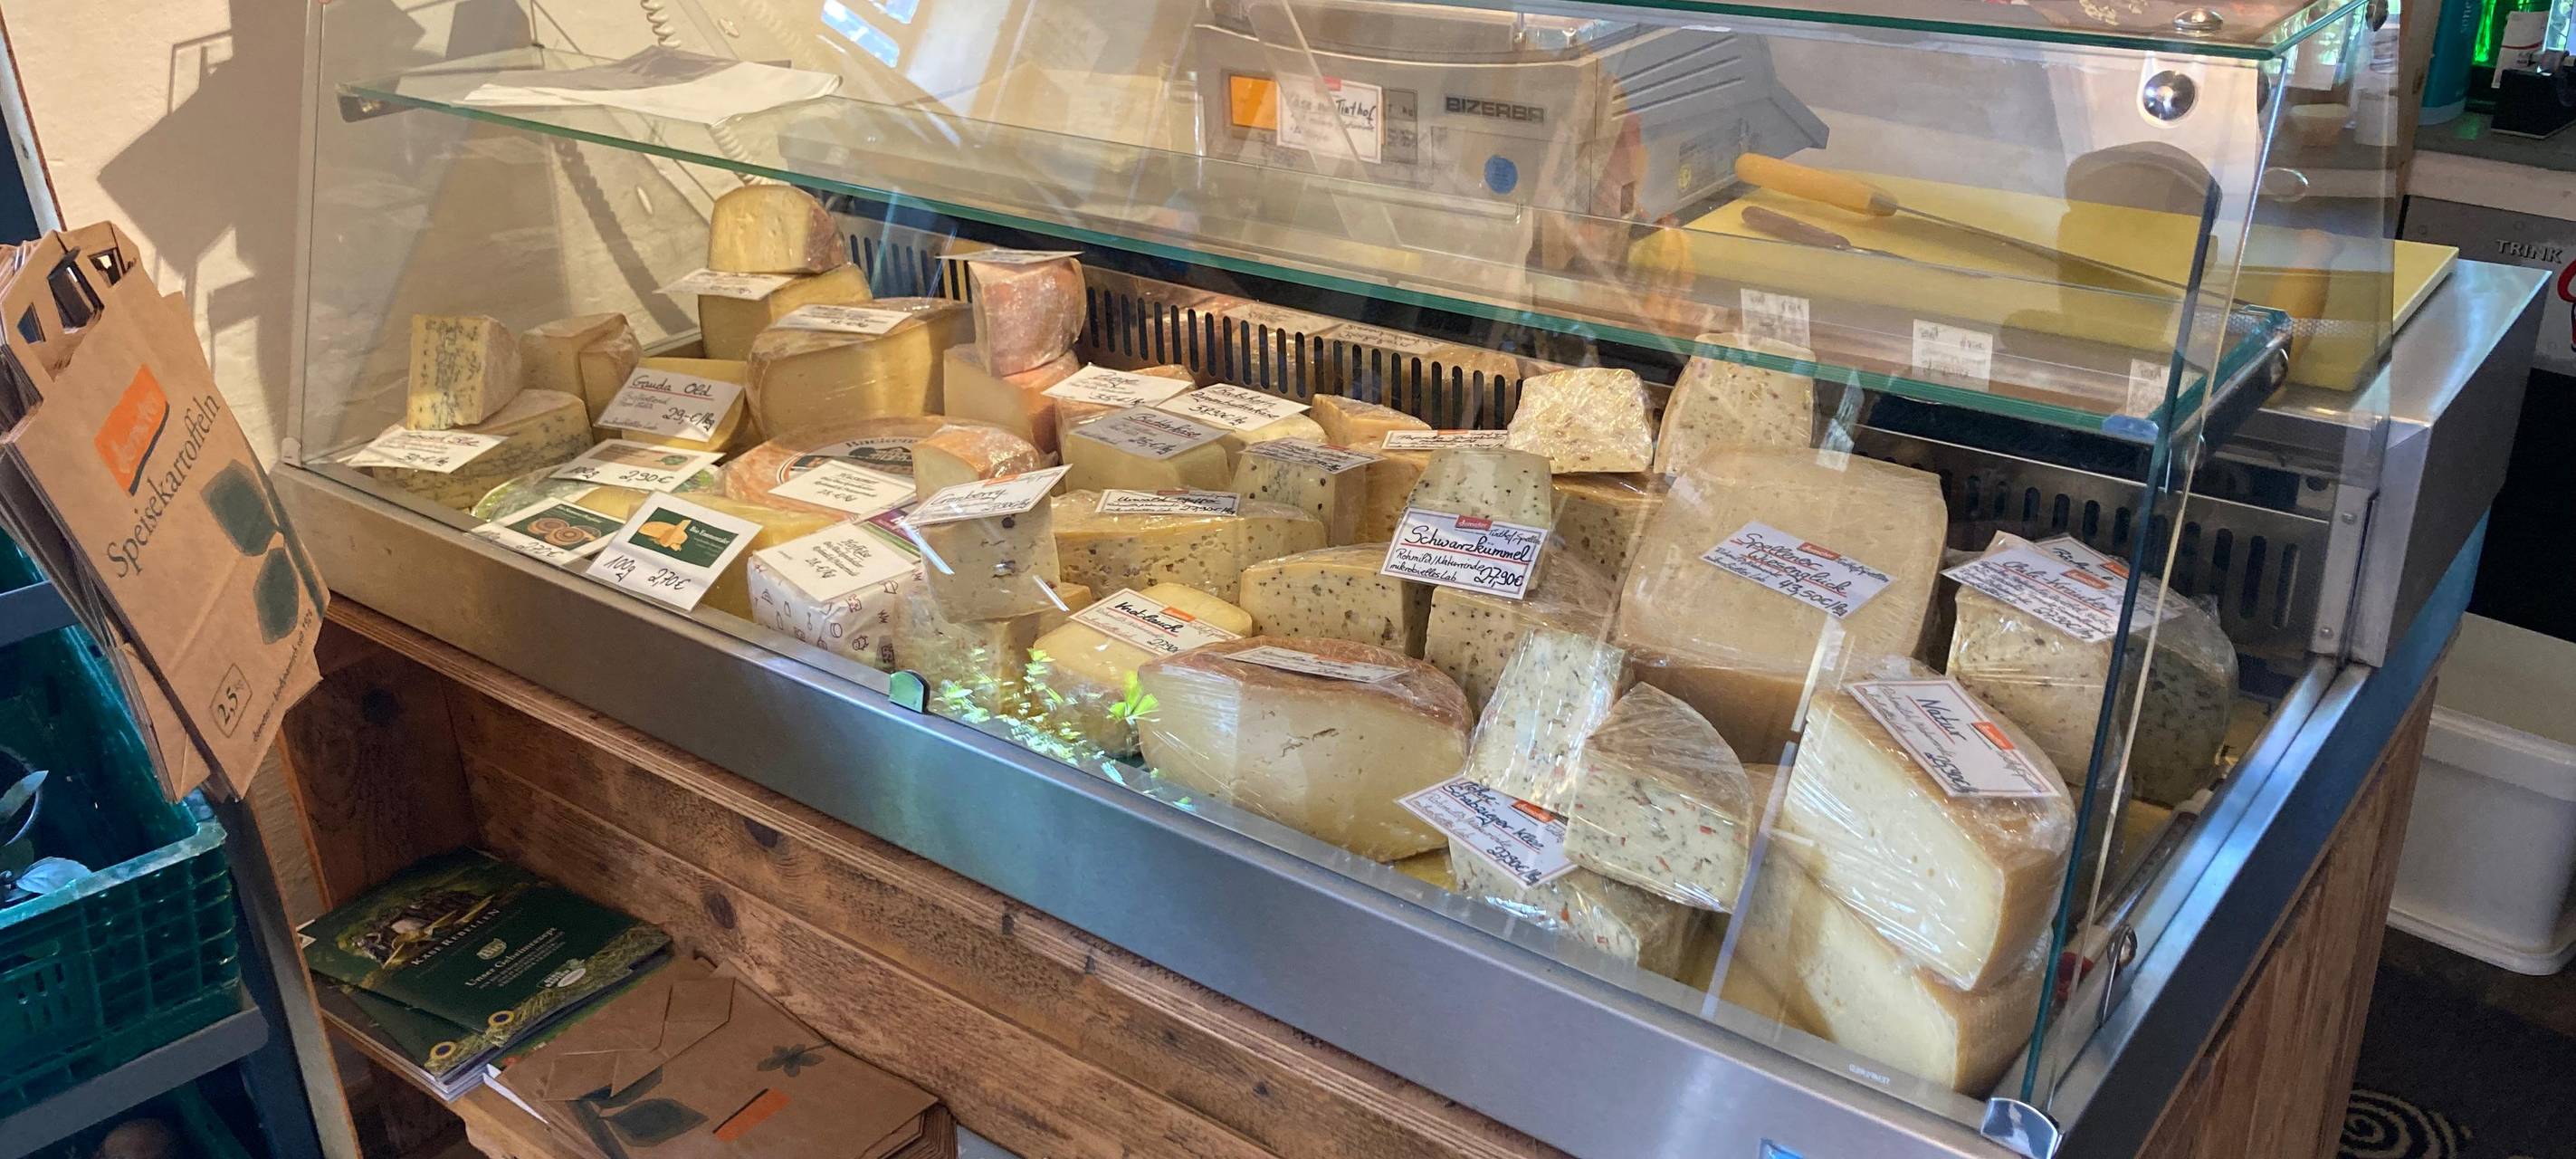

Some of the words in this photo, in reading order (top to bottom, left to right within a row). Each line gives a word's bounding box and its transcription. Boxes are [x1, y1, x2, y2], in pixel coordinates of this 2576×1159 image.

[1445, 95, 1545, 123] BIZERBA
[2495, 239, 2563, 264] TRINK
[684, 381, 715, 397] Old
[107, 393, 222, 580] Speisekartoffeln
[1457, 519, 1489, 529] demeter
[1404, 524, 1533, 563] Schwarzkümmel
[1736, 532, 1824, 569] Spellener
[603, 554, 636, 582] 100g
[647, 568, 692, 590] 2,70€
[1746, 549, 1853, 594] Wiesenglück
[1114, 601, 1184, 634] Knoblauch
[1915, 697, 1969, 742] Natur
